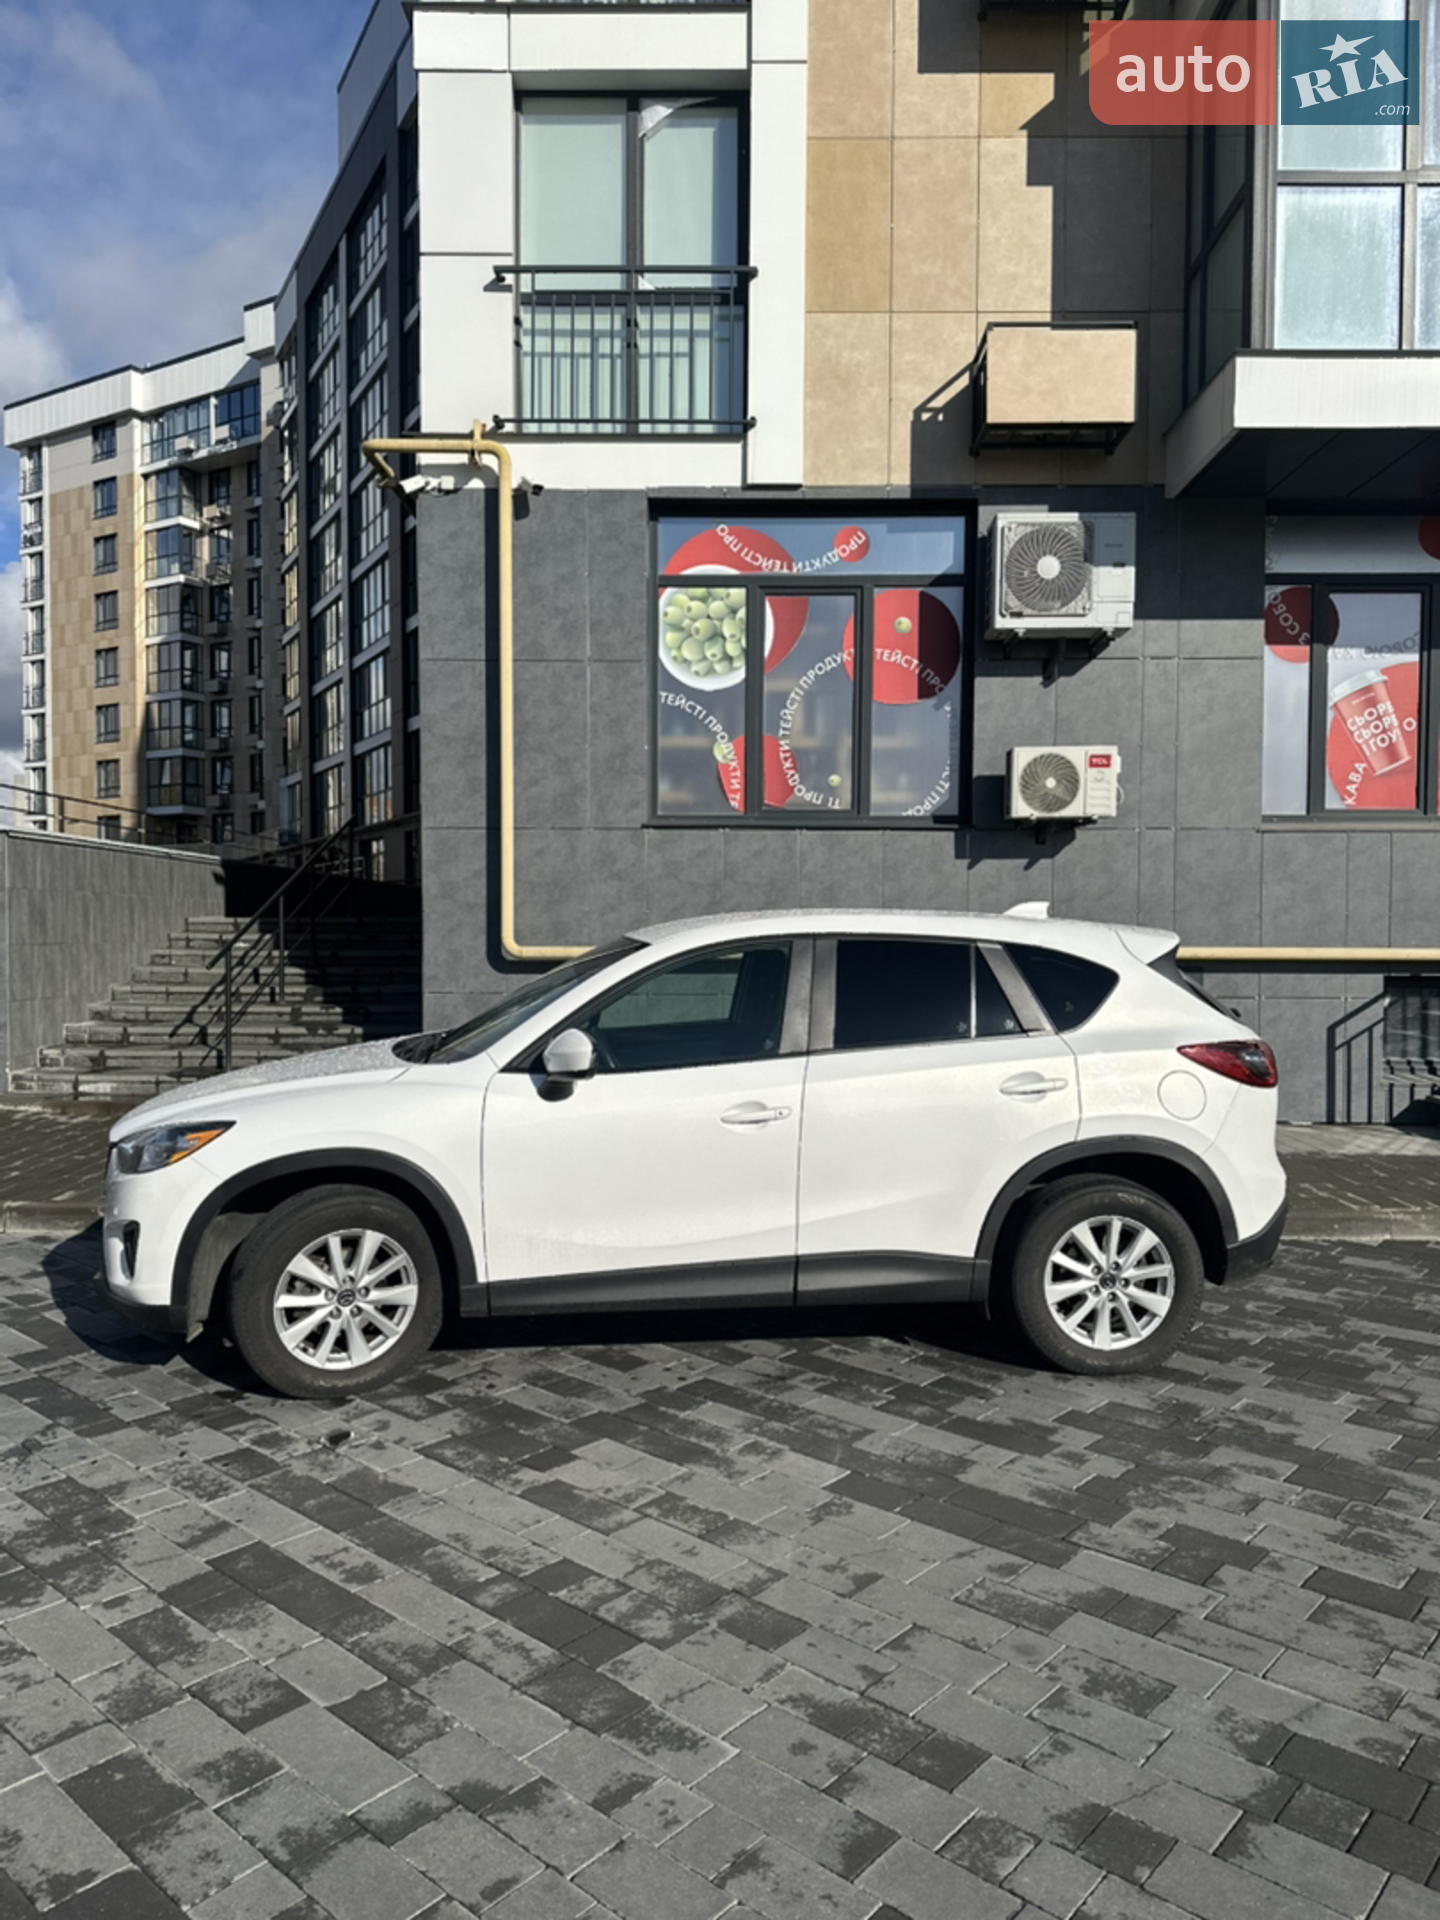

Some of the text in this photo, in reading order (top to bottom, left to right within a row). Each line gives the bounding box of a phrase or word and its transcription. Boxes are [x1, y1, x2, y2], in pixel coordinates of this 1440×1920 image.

[740, 547, 789, 573] ТЕЙСТІ
[793, 530, 866, 573] ПРОДУКТИ
[875, 648, 923, 675] ТЕЙСТІ
[659, 691, 707, 720] ТЕЙСТІ
[778, 687, 805, 737] ТЕЙСТІ
[778, 740, 824, 805] ПРОДУКТИ
[1344, 762, 1367, 805] КАВА
